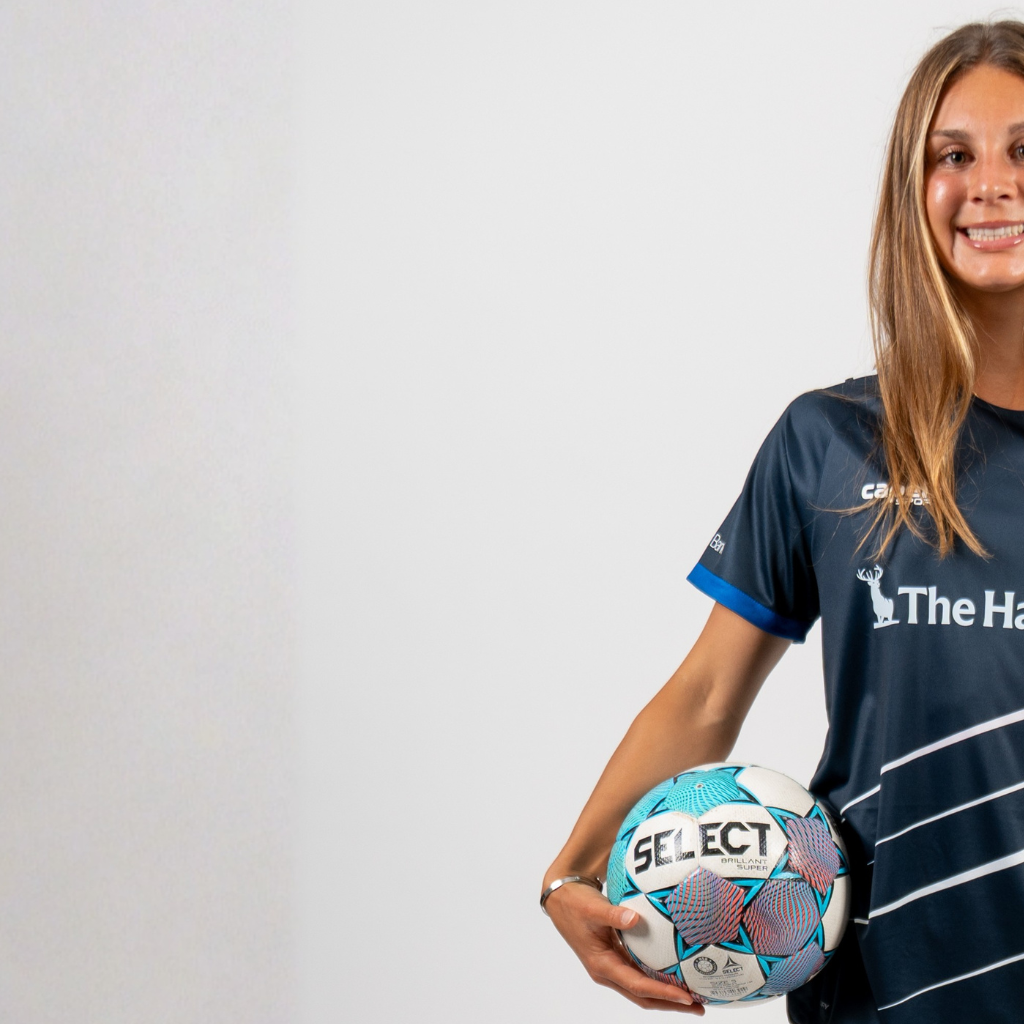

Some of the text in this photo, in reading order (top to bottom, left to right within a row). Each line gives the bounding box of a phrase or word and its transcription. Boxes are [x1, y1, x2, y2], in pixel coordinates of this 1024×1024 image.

[897, 586, 976, 627] The
[633, 821, 771, 875] SELECT
[722, 966, 743, 974] SELECT
